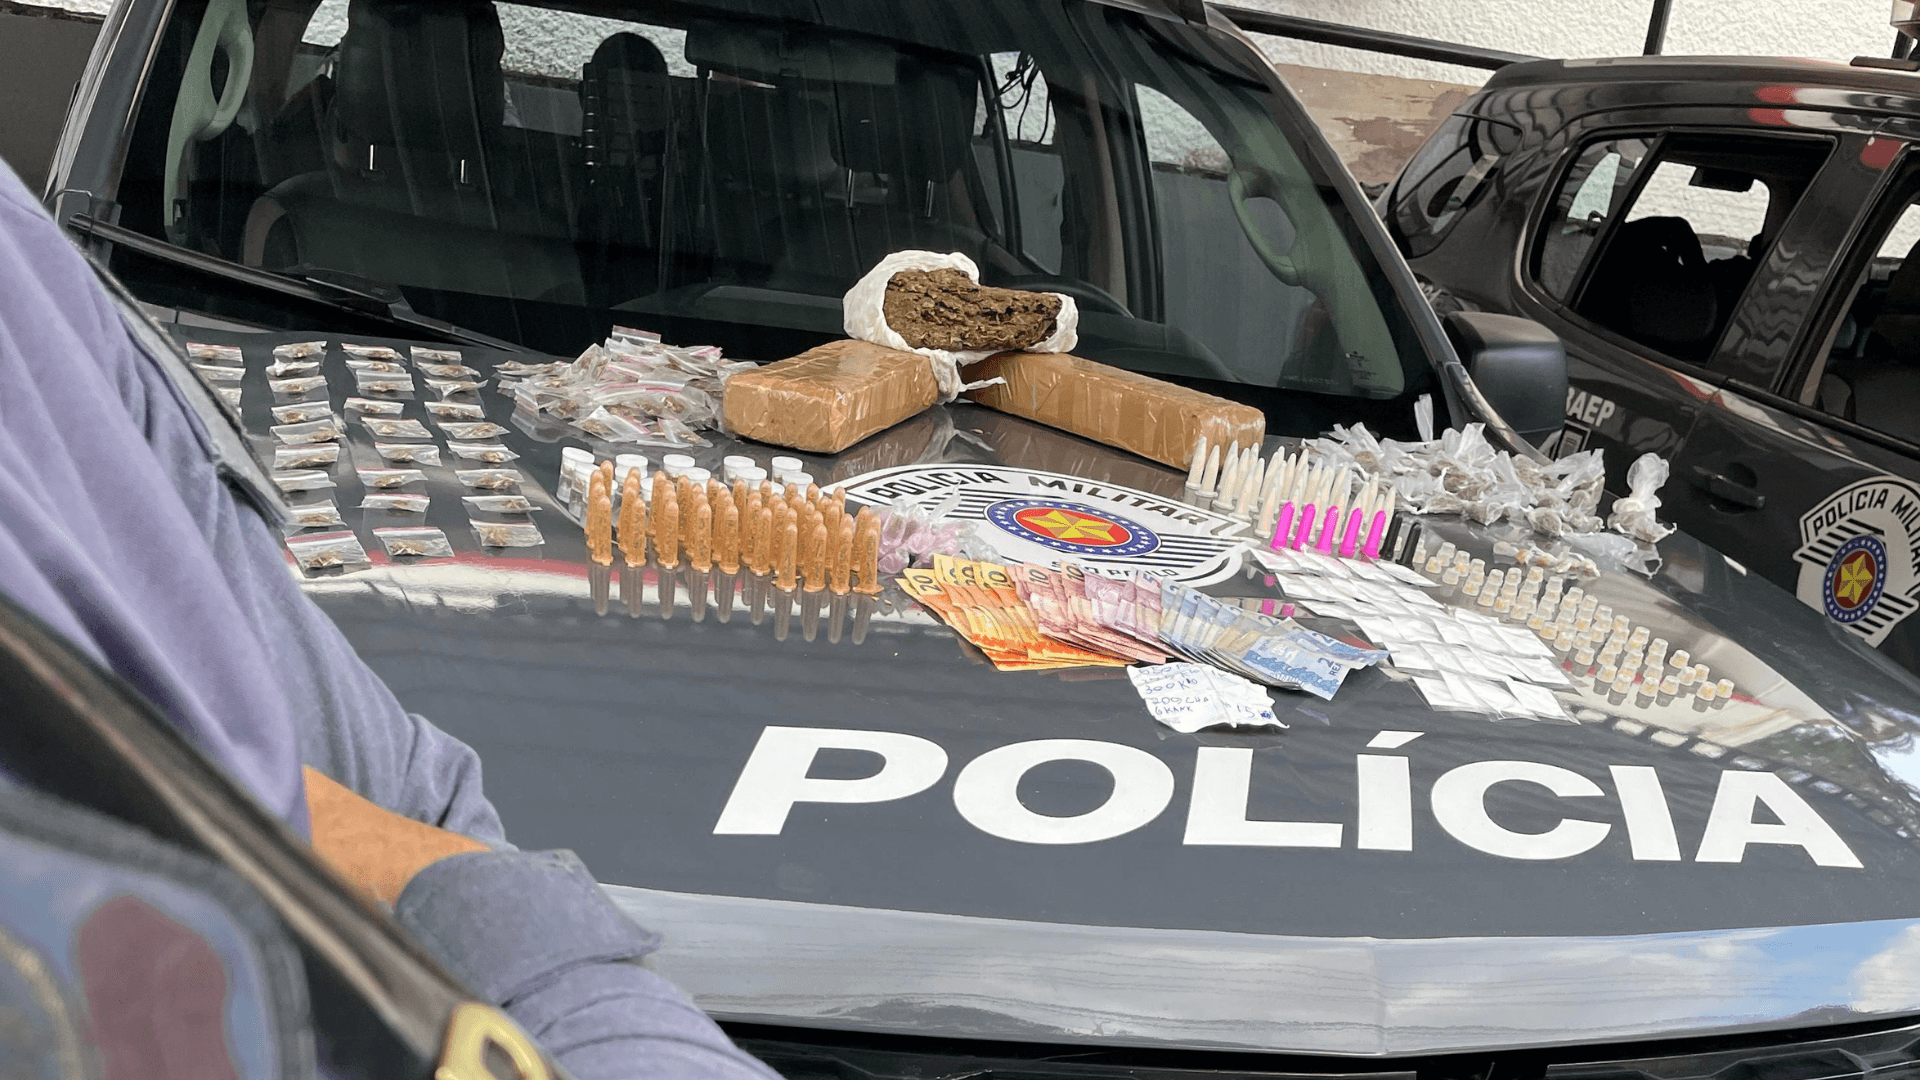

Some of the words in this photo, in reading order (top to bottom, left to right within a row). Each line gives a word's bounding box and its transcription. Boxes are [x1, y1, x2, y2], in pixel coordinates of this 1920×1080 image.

[866, 471, 1010, 499] POLICIA
[1028, 475, 1209, 525] MILITAR
[1813, 488, 1889, 537] POLICIA
[1029, 569, 1049, 585] 10
[1066, 565, 1084, 582] 10
[1317, 657, 1335, 668] 2
[713, 726, 1865, 869] POLÍCIA
